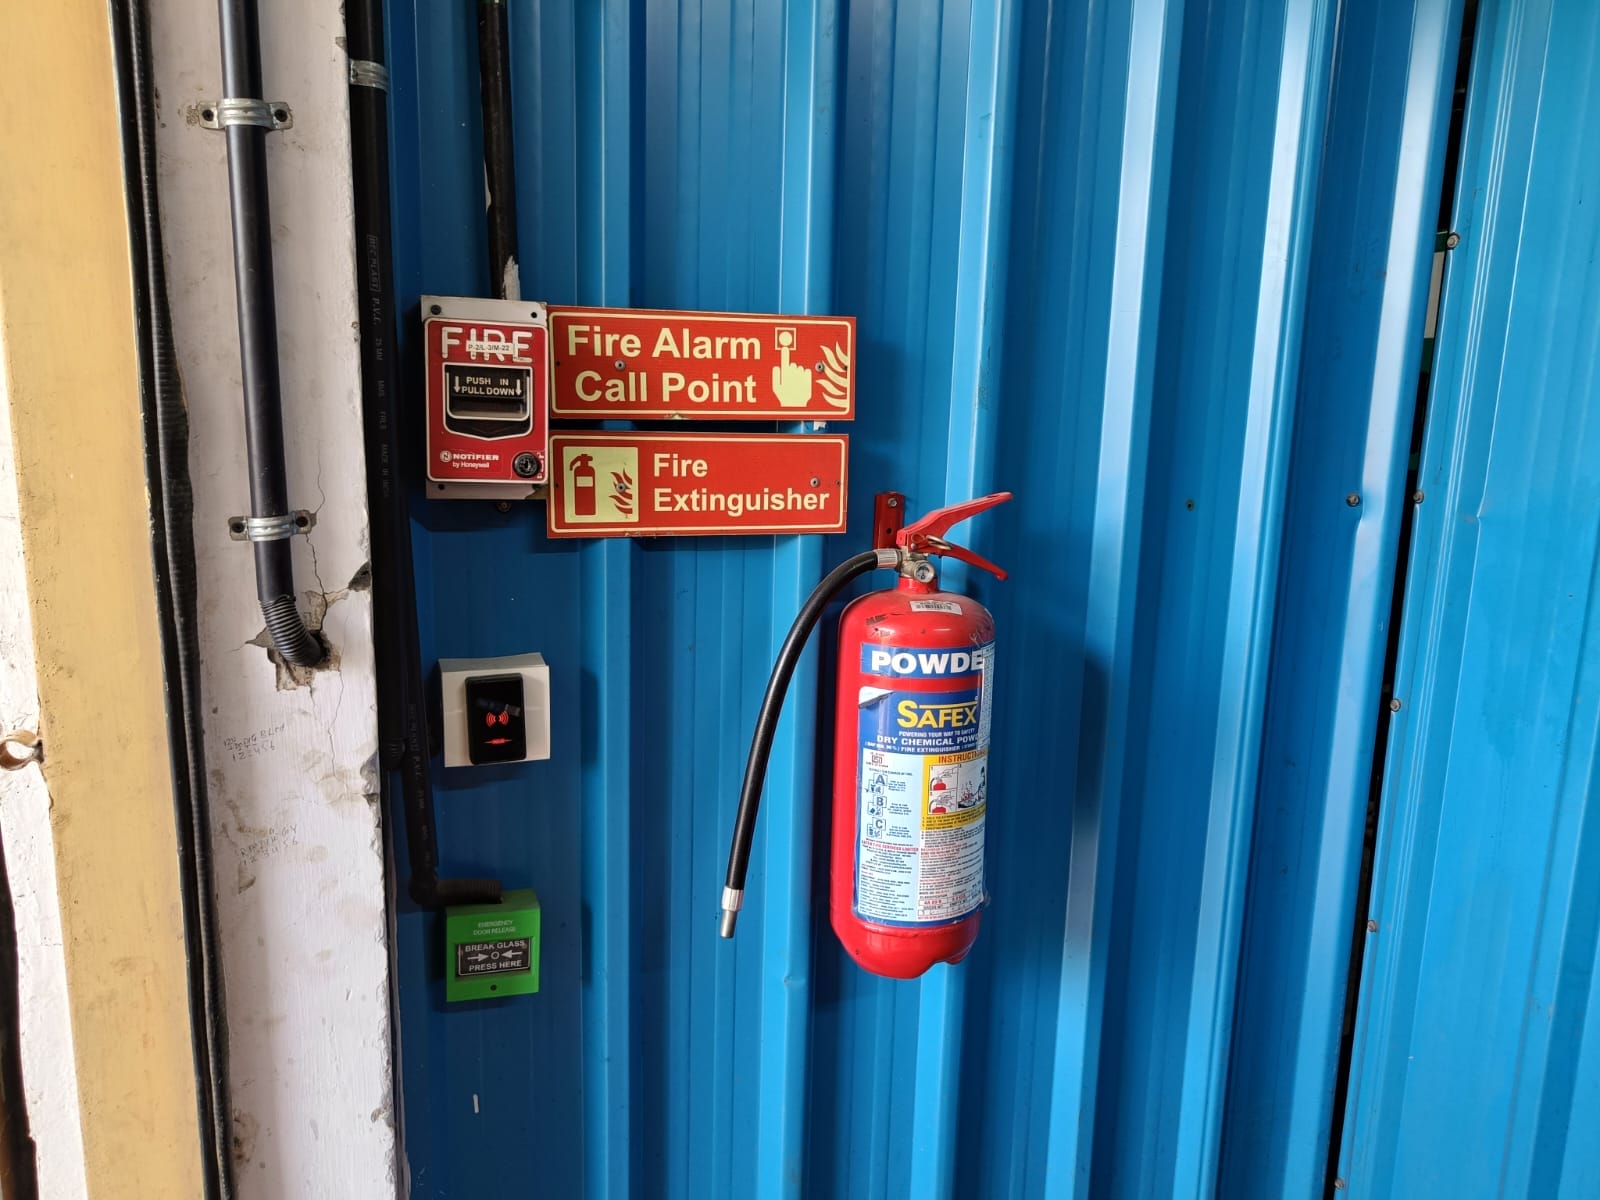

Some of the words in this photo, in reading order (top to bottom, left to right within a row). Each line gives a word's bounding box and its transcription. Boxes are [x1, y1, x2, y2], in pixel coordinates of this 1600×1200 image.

[442, 326, 533, 363] FIRE
[568, 324, 642, 357] Fire
[651, 327, 761, 360] Alarm
[466, 376, 491, 385] PUSH
[500, 378, 509, 386] IN
[575, 370, 647, 402] Call
[661, 372, 756, 403] Point
[462, 386, 486, 395] PULL
[486, 387, 515, 396] DOWN
[654, 452, 708, 477] Fire
[654, 487, 830, 517] Extinguisher
[897, 700, 976, 728] SAFEX
[877, 735, 898, 744] DRY
[901, 738, 954, 746] CHEMICAL
[938, 749, 986, 764] INSTRUCTI
[875, 774, 885, 785] A
[876, 797, 884, 806] B
[875, 819, 883, 829] C
[465, 944, 495, 952] BREAK
[496, 940, 525, 949] GLASS
[469, 963, 497, 972] PRESS
